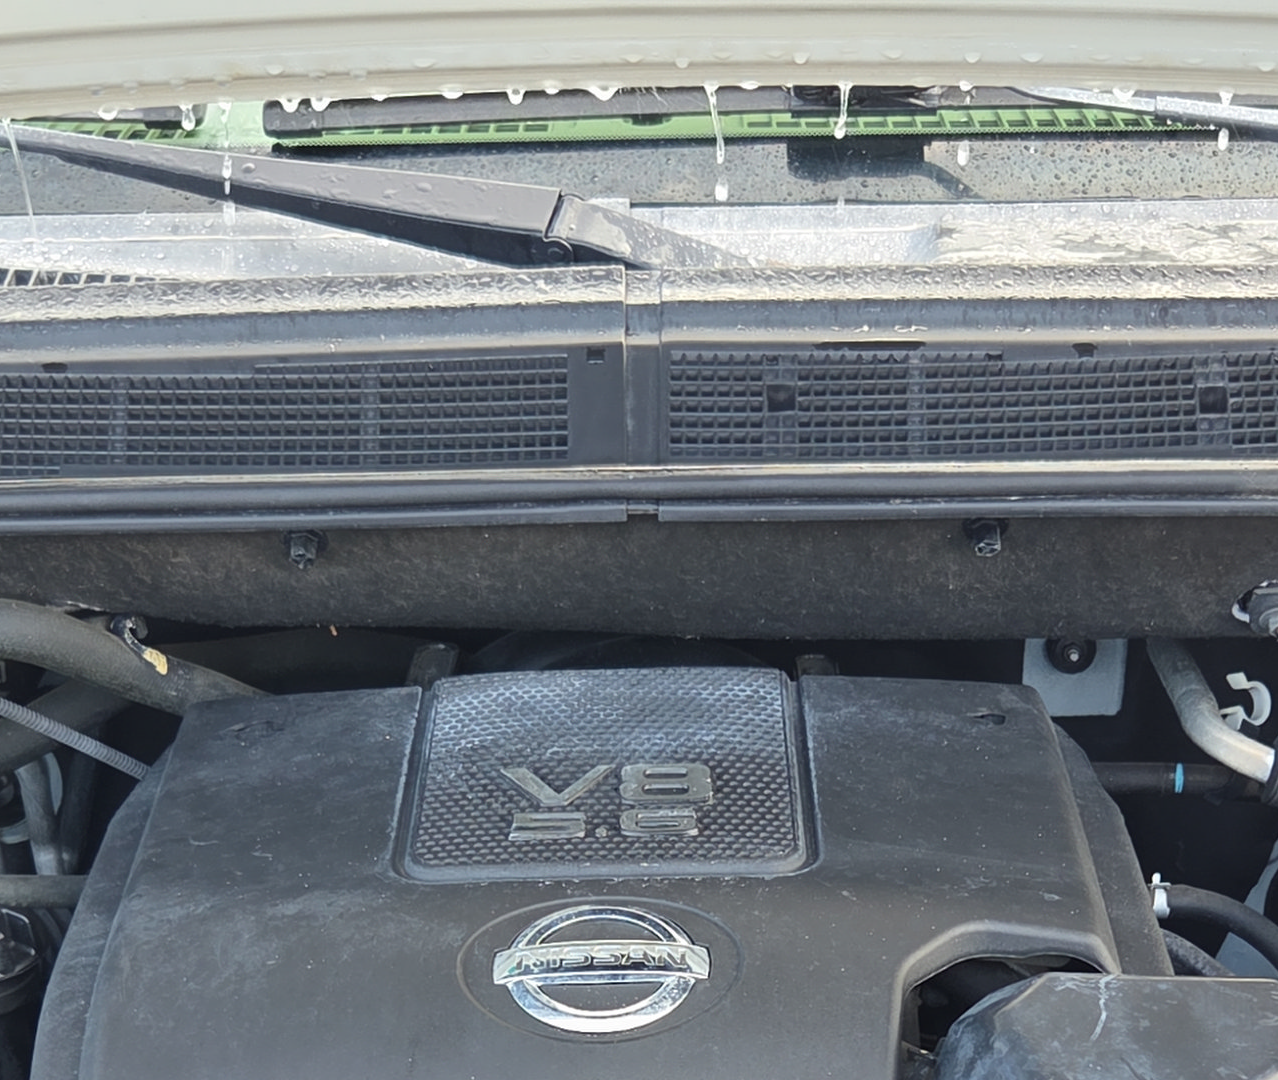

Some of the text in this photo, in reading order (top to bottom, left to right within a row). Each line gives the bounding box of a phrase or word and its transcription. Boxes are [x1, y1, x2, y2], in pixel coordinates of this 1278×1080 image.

[500, 763, 716, 807] V8
[508, 807, 699, 841] 5.6
[514, 944, 688, 970] NISSAN
